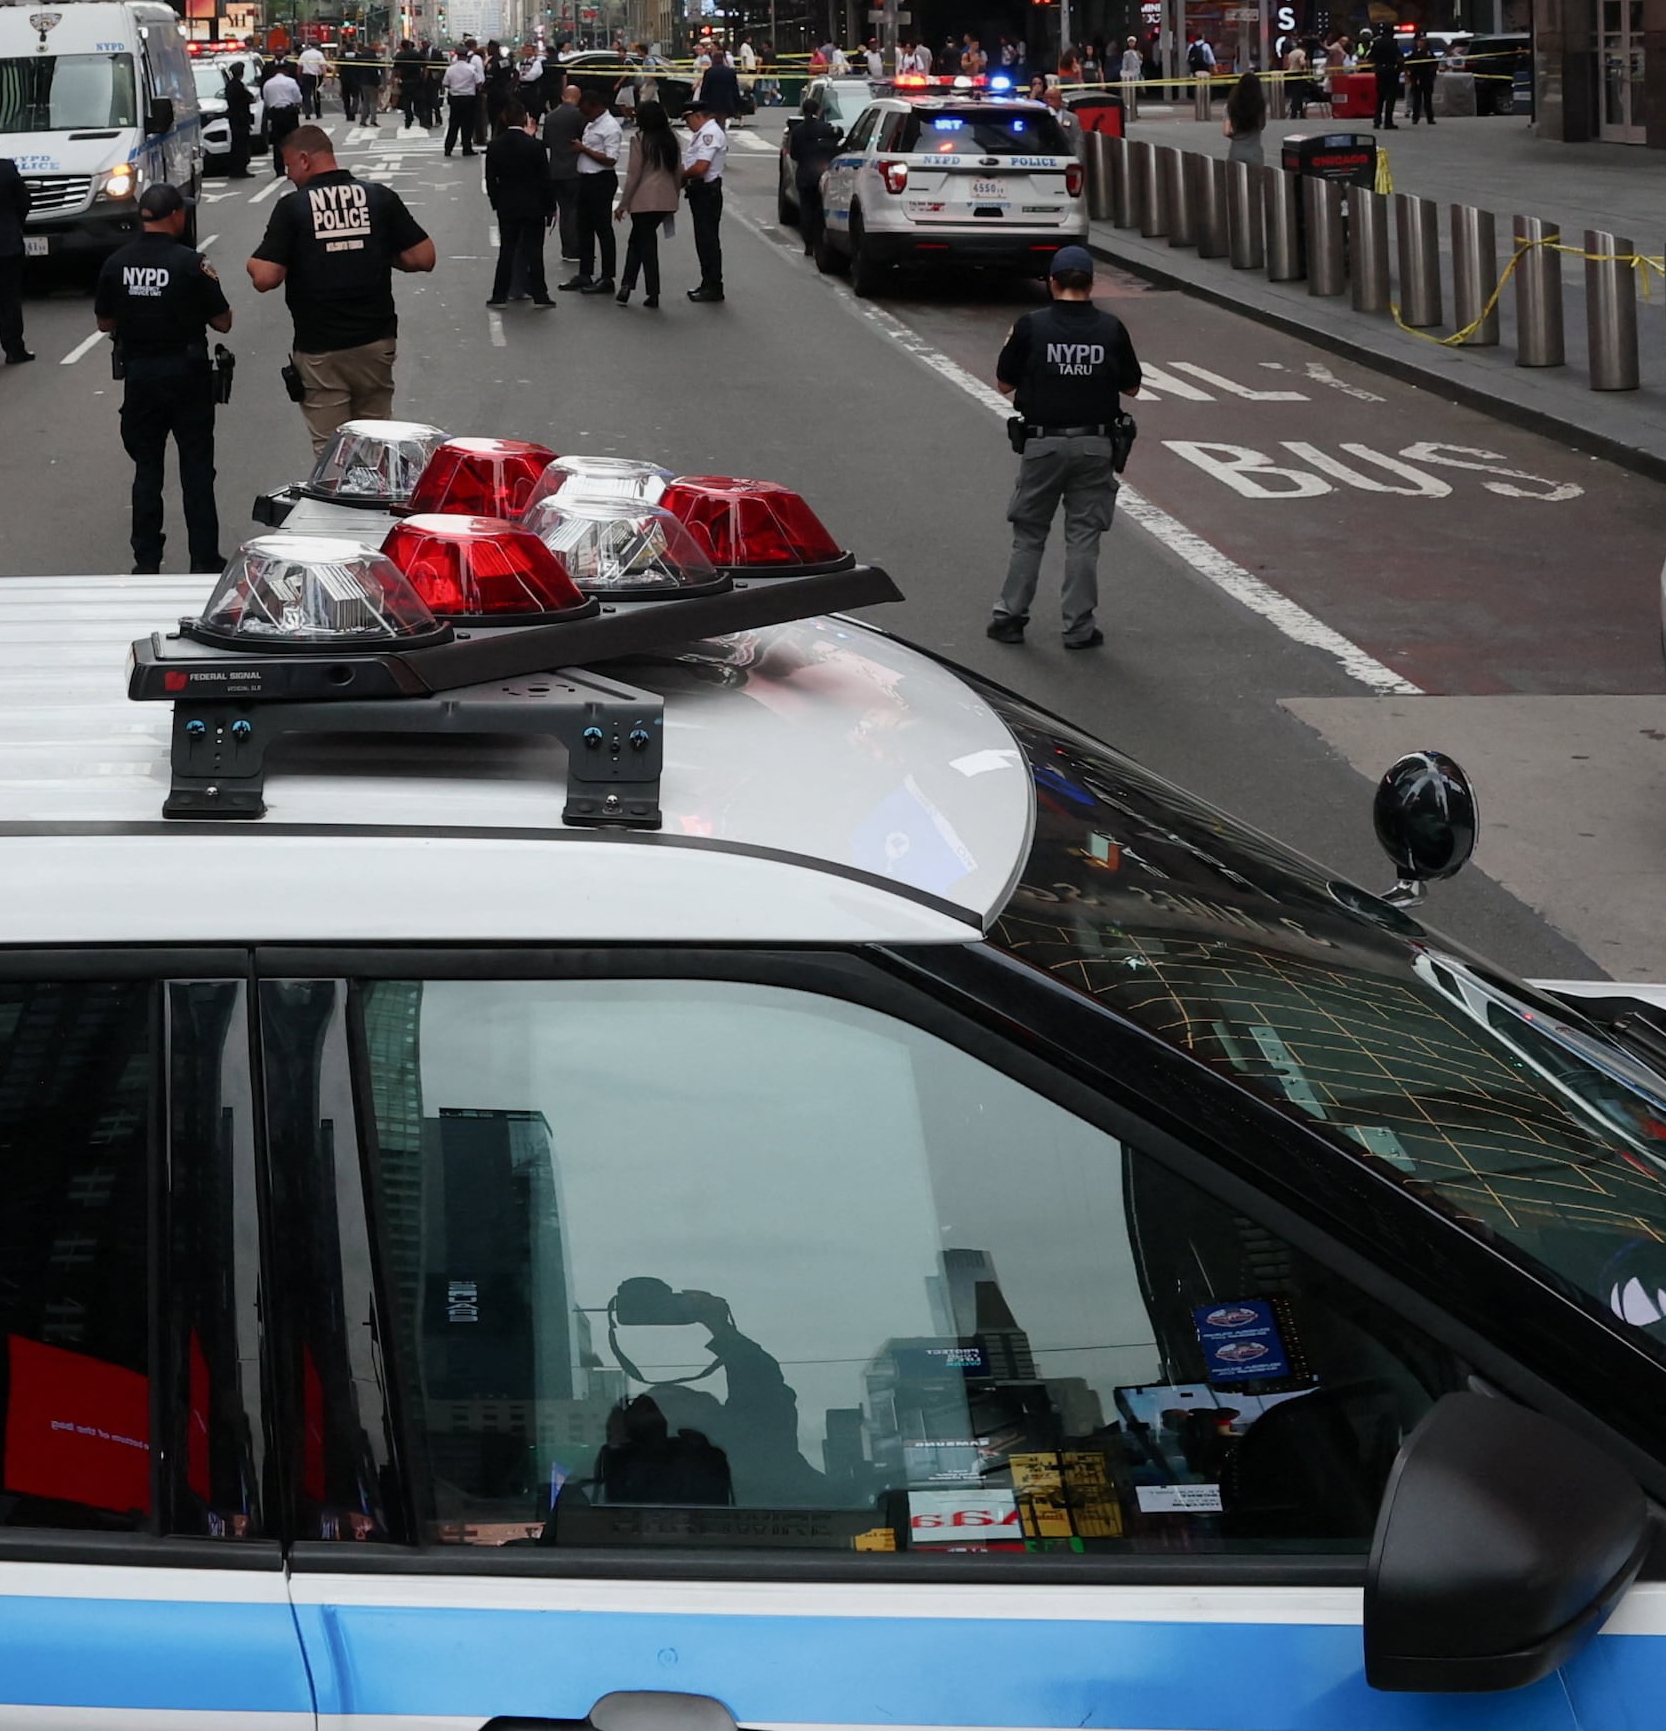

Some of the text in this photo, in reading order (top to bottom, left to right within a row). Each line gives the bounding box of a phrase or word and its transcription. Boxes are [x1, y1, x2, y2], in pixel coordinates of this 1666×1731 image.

[96, 42, 125, 52] NYPD
[17, 162, 60, 170] LICE
[923, 155, 1057, 167] NYPD POLICE
[309, 184, 367, 211] NYPD
[313, 207, 371, 231] POLICE
[123, 266, 170, 287] NYPD
[1046, 342, 1105, 365] NYPD
[1058, 363, 1093, 376] TARU
[1161, 440, 1585, 502] BUS
